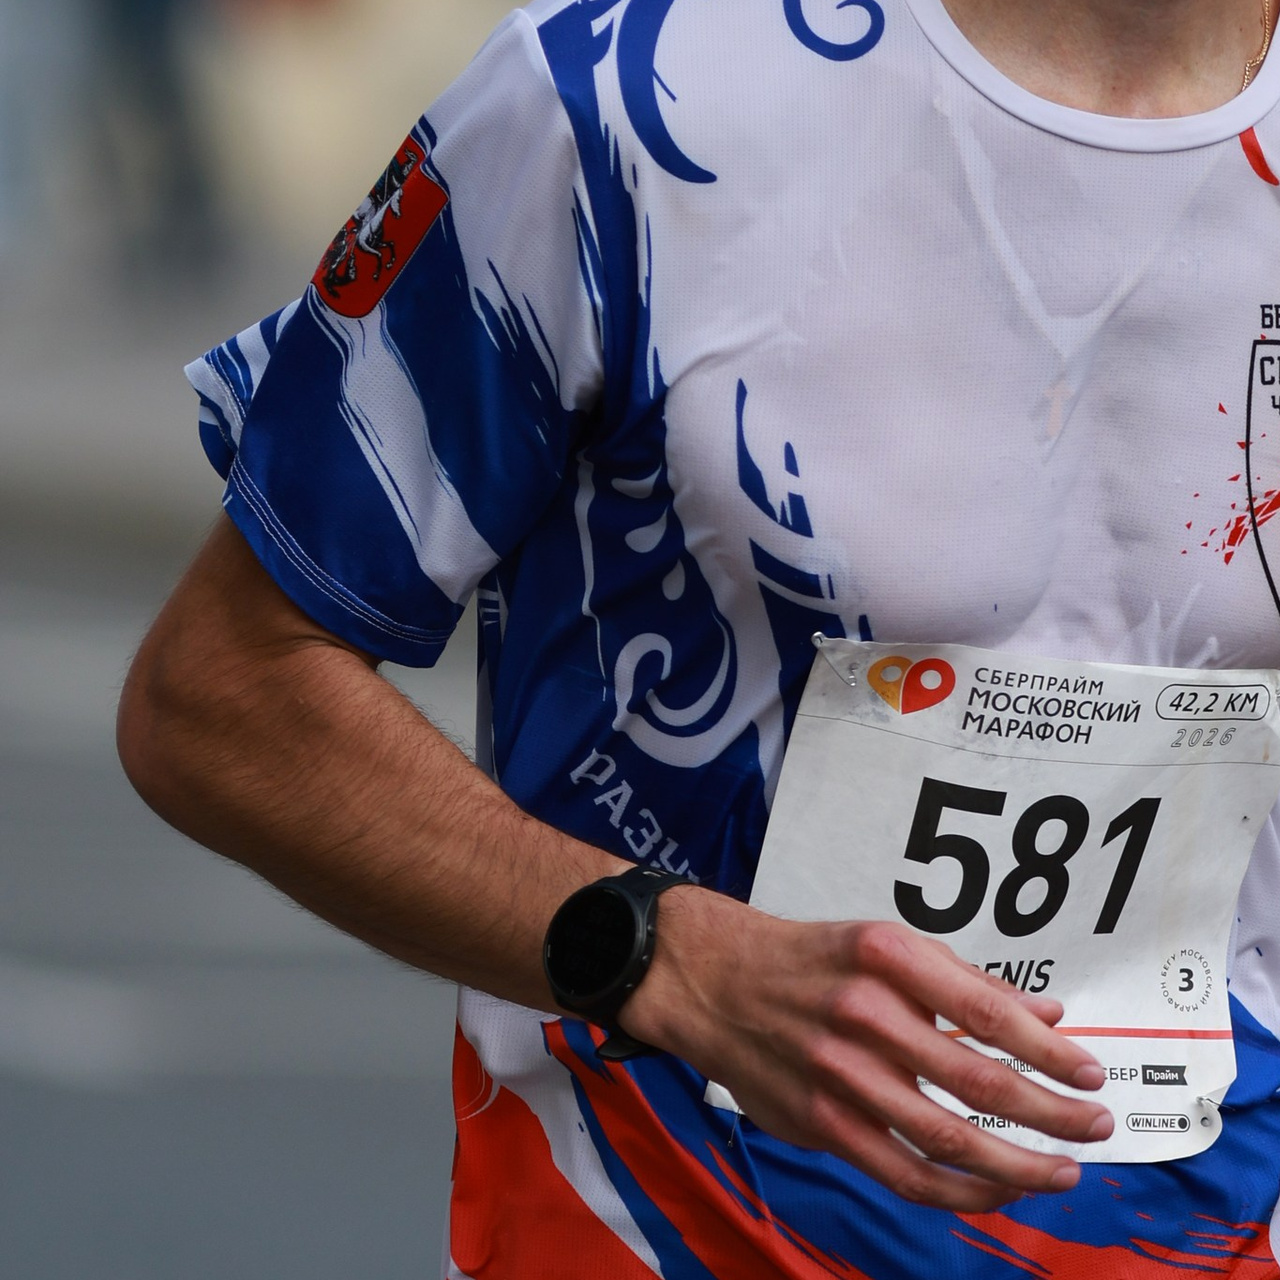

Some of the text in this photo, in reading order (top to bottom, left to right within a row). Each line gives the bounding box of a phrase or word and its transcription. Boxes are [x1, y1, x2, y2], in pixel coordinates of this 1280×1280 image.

[975, 667, 1104, 696] СБЕРПРАЙМ
[968, 686, 1142, 724] МОСКОВСКИЙ
[1168, 691, 1260, 716] 42,2 КМ
[962, 711, 1093, 745] МАРАФОН
[1171, 727, 1237, 749] 2026
[569, 747, 700, 885] РАЗУ
[893, 776, 1163, 938] 581
[970, 959, 1056, 993] NIS
[1178, 968, 1195, 992] 3
[1146, 1069, 1179, 1082] Прайм
[1131, 1117, 1176, 1129] WINLINE
